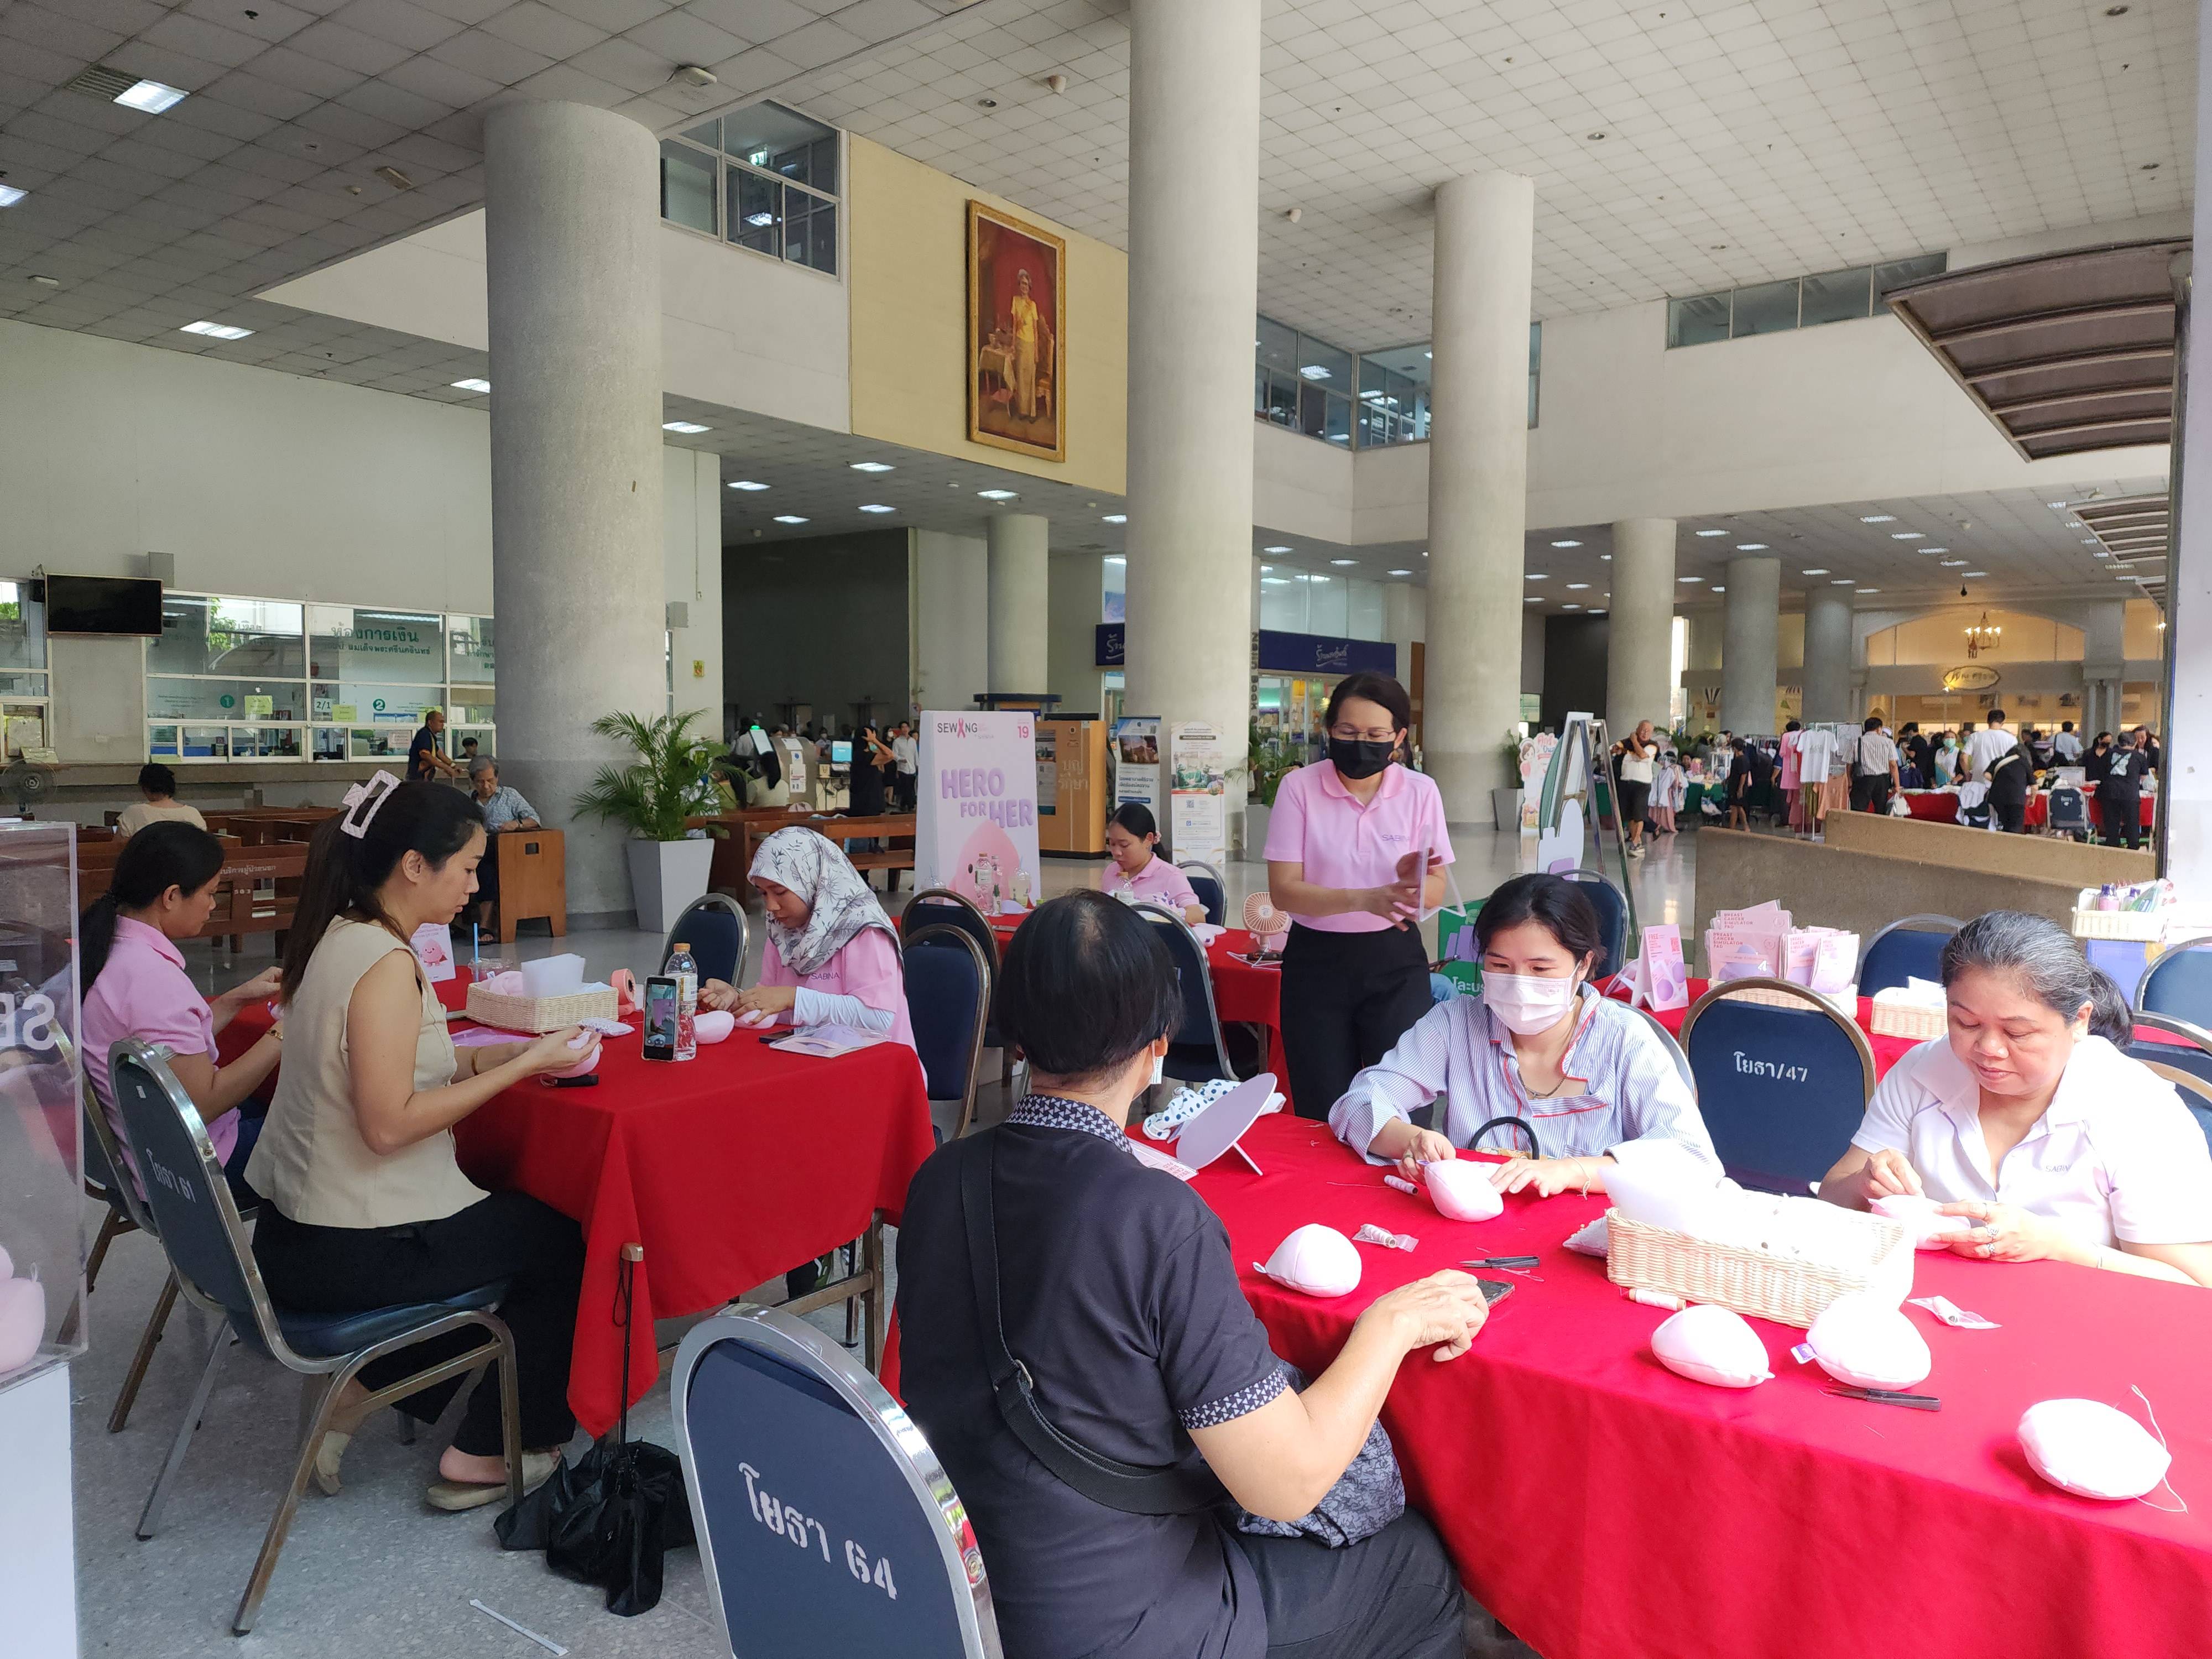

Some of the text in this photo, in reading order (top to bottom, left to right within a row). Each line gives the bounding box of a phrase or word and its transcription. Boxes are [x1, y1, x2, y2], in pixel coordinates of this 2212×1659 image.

[375, 701, 383, 709] 2
[1018, 726, 1029, 739] 19
[941, 767, 1005, 799] HERO
[960, 799, 1034, 828] FOR HER
[1734, 1051, 1808, 1082] โยธา/47
[2045, 1164, 2070, 1172] SABIN
[178, 1176, 196, 1204] 61
[739, 1462, 898, 1600] โยธา 64
